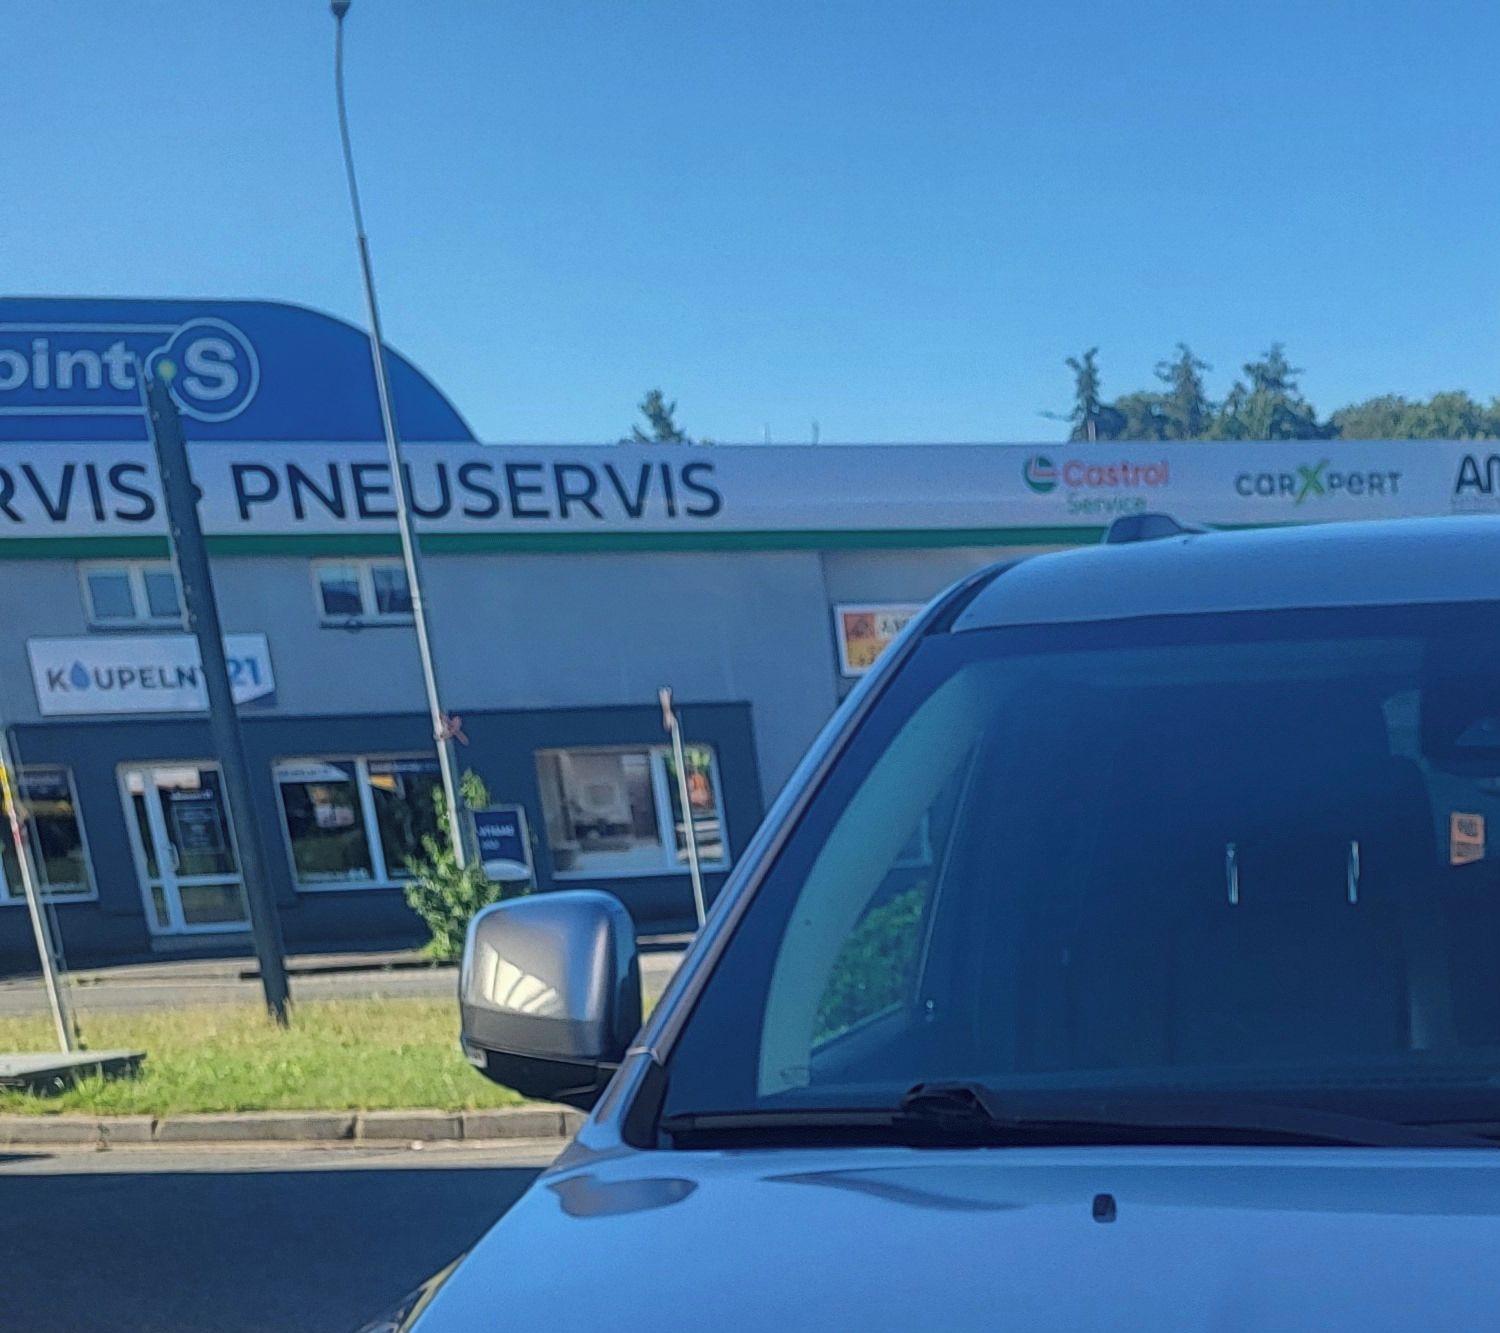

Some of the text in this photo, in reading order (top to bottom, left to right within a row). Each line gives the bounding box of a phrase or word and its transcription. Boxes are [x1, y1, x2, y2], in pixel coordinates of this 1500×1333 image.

[182, 337, 240, 401] S
[231, 461, 724, 521] PNEUSERVIS
[1063, 460, 1169, 488] Castrol
